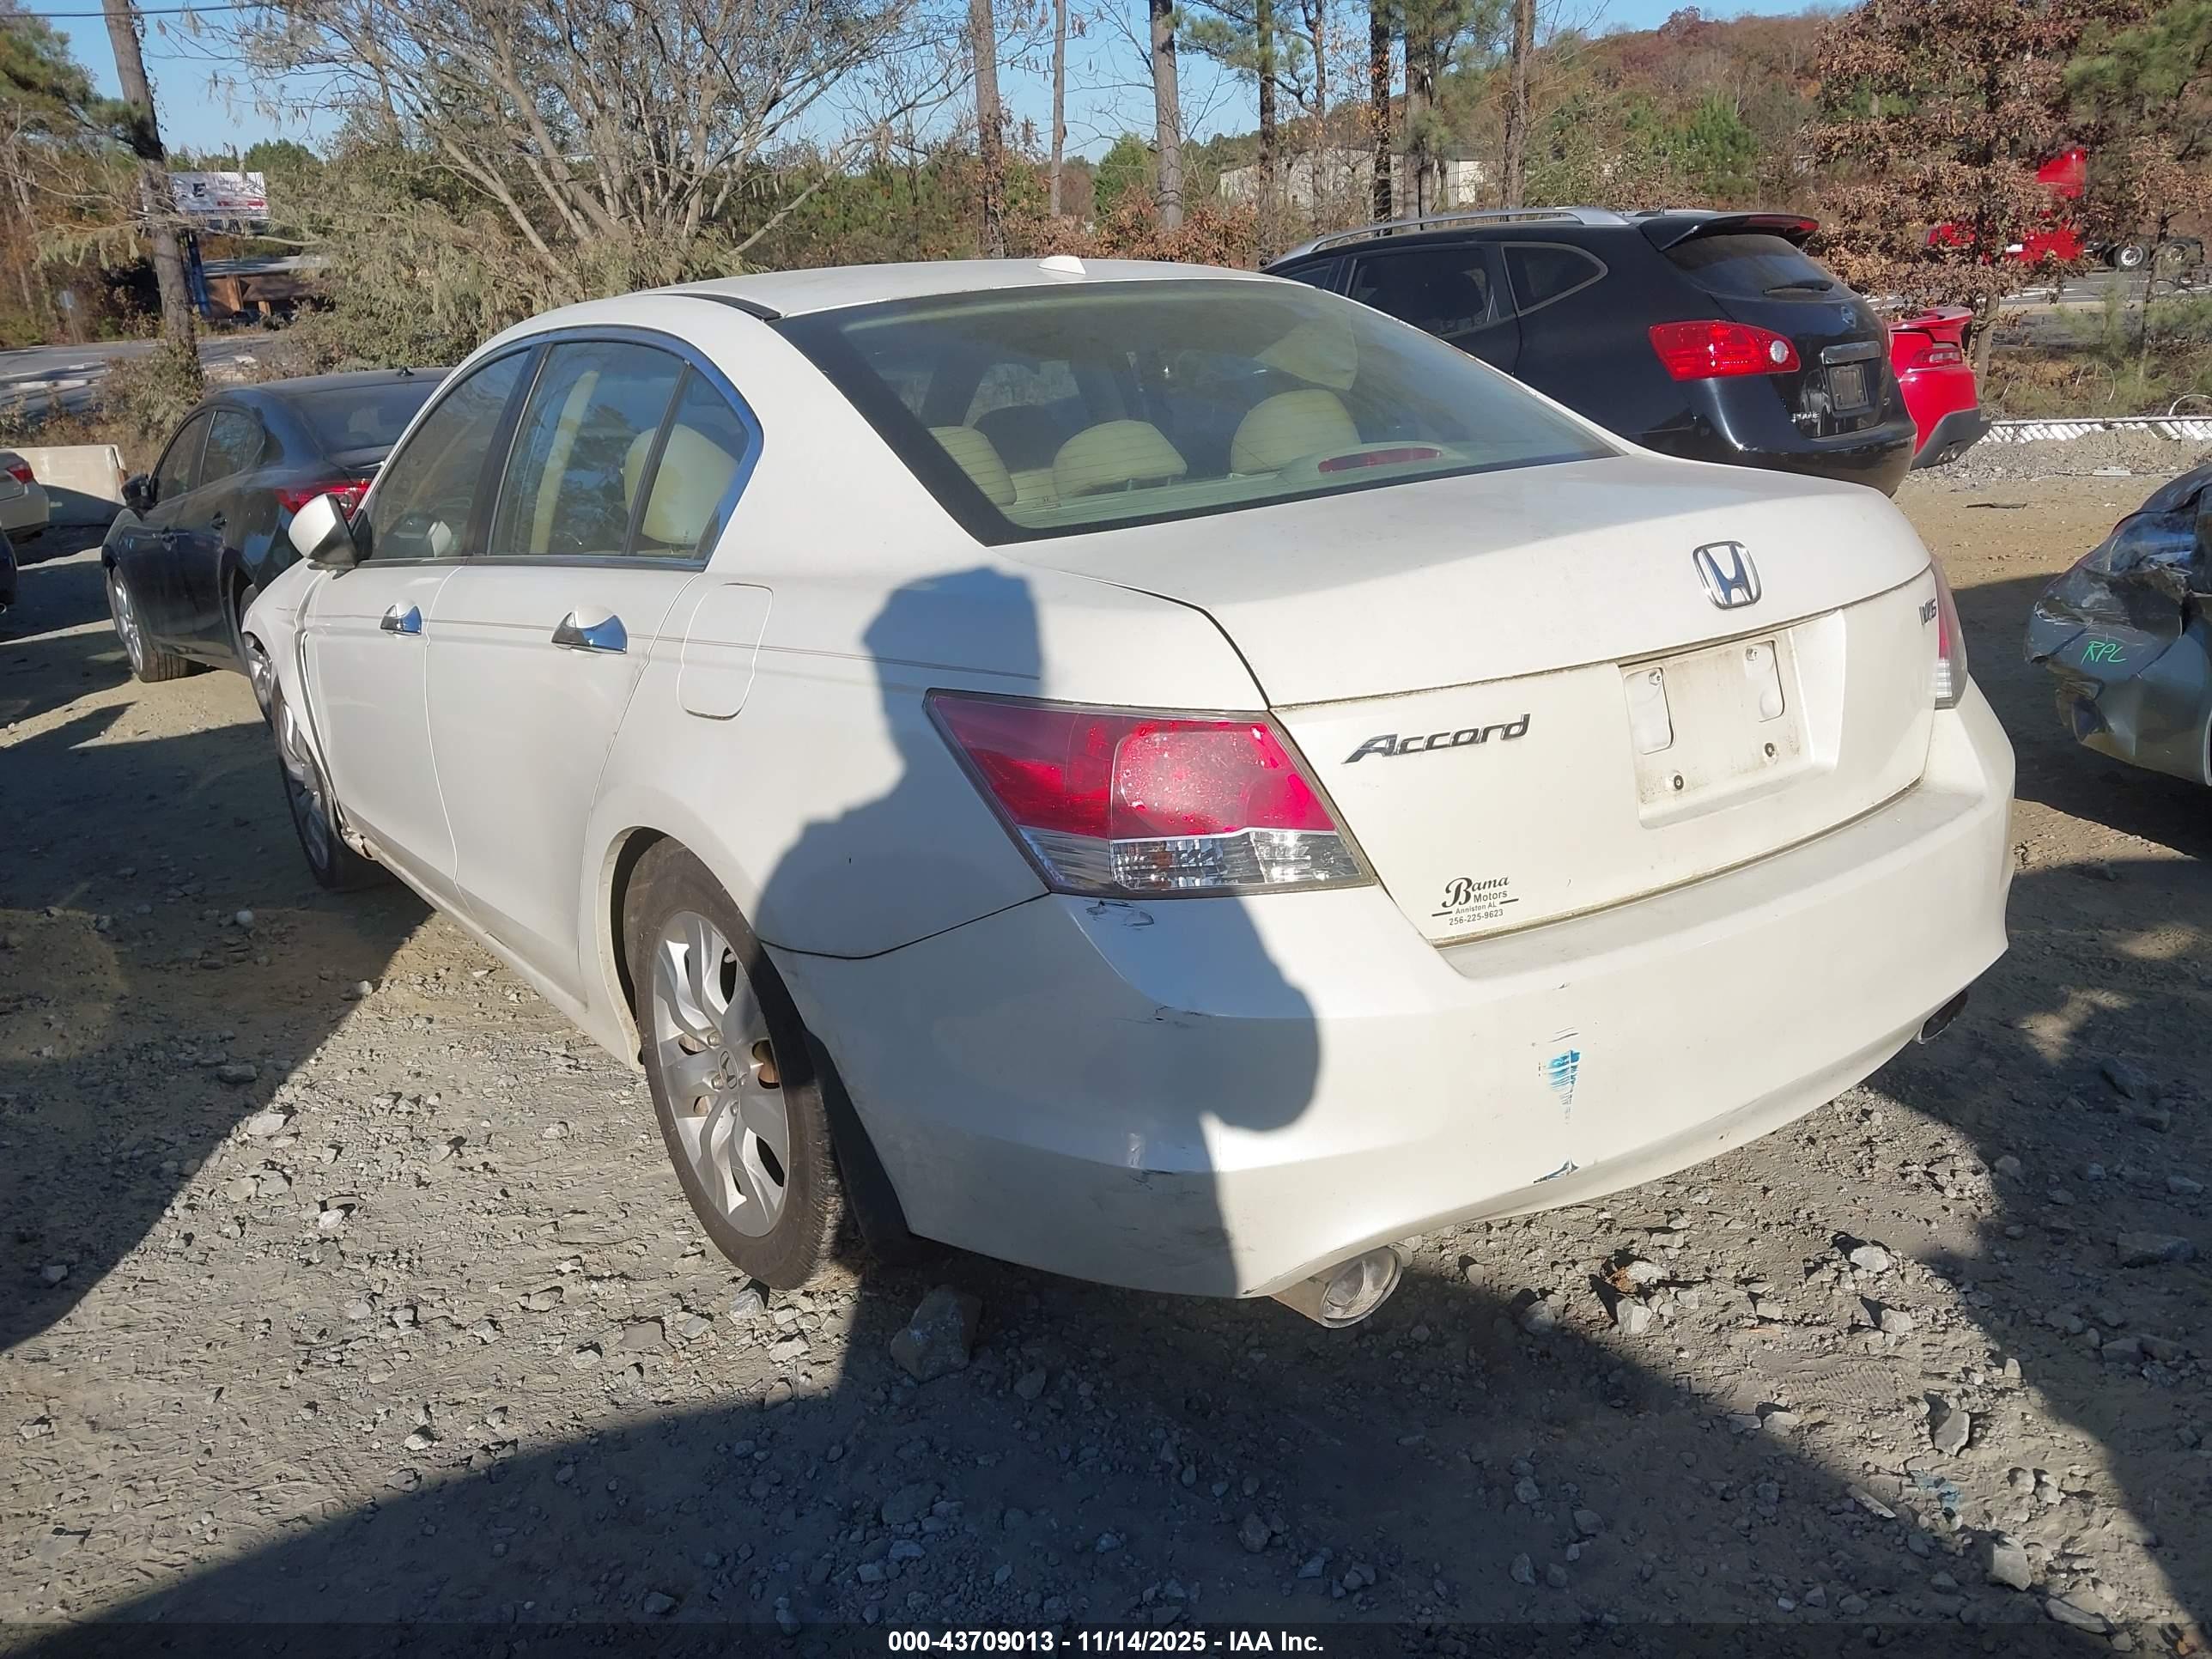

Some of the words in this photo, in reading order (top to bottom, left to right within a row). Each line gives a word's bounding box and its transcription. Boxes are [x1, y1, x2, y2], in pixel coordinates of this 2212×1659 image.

[1340, 713, 1531, 764] Accord
[1441, 876, 1510, 908] Bama
[1474, 890, 1508, 904] Motors
[1449, 908, 1504, 926] 256-225-9623
[1455, 904, 1486, 915] Anniston
